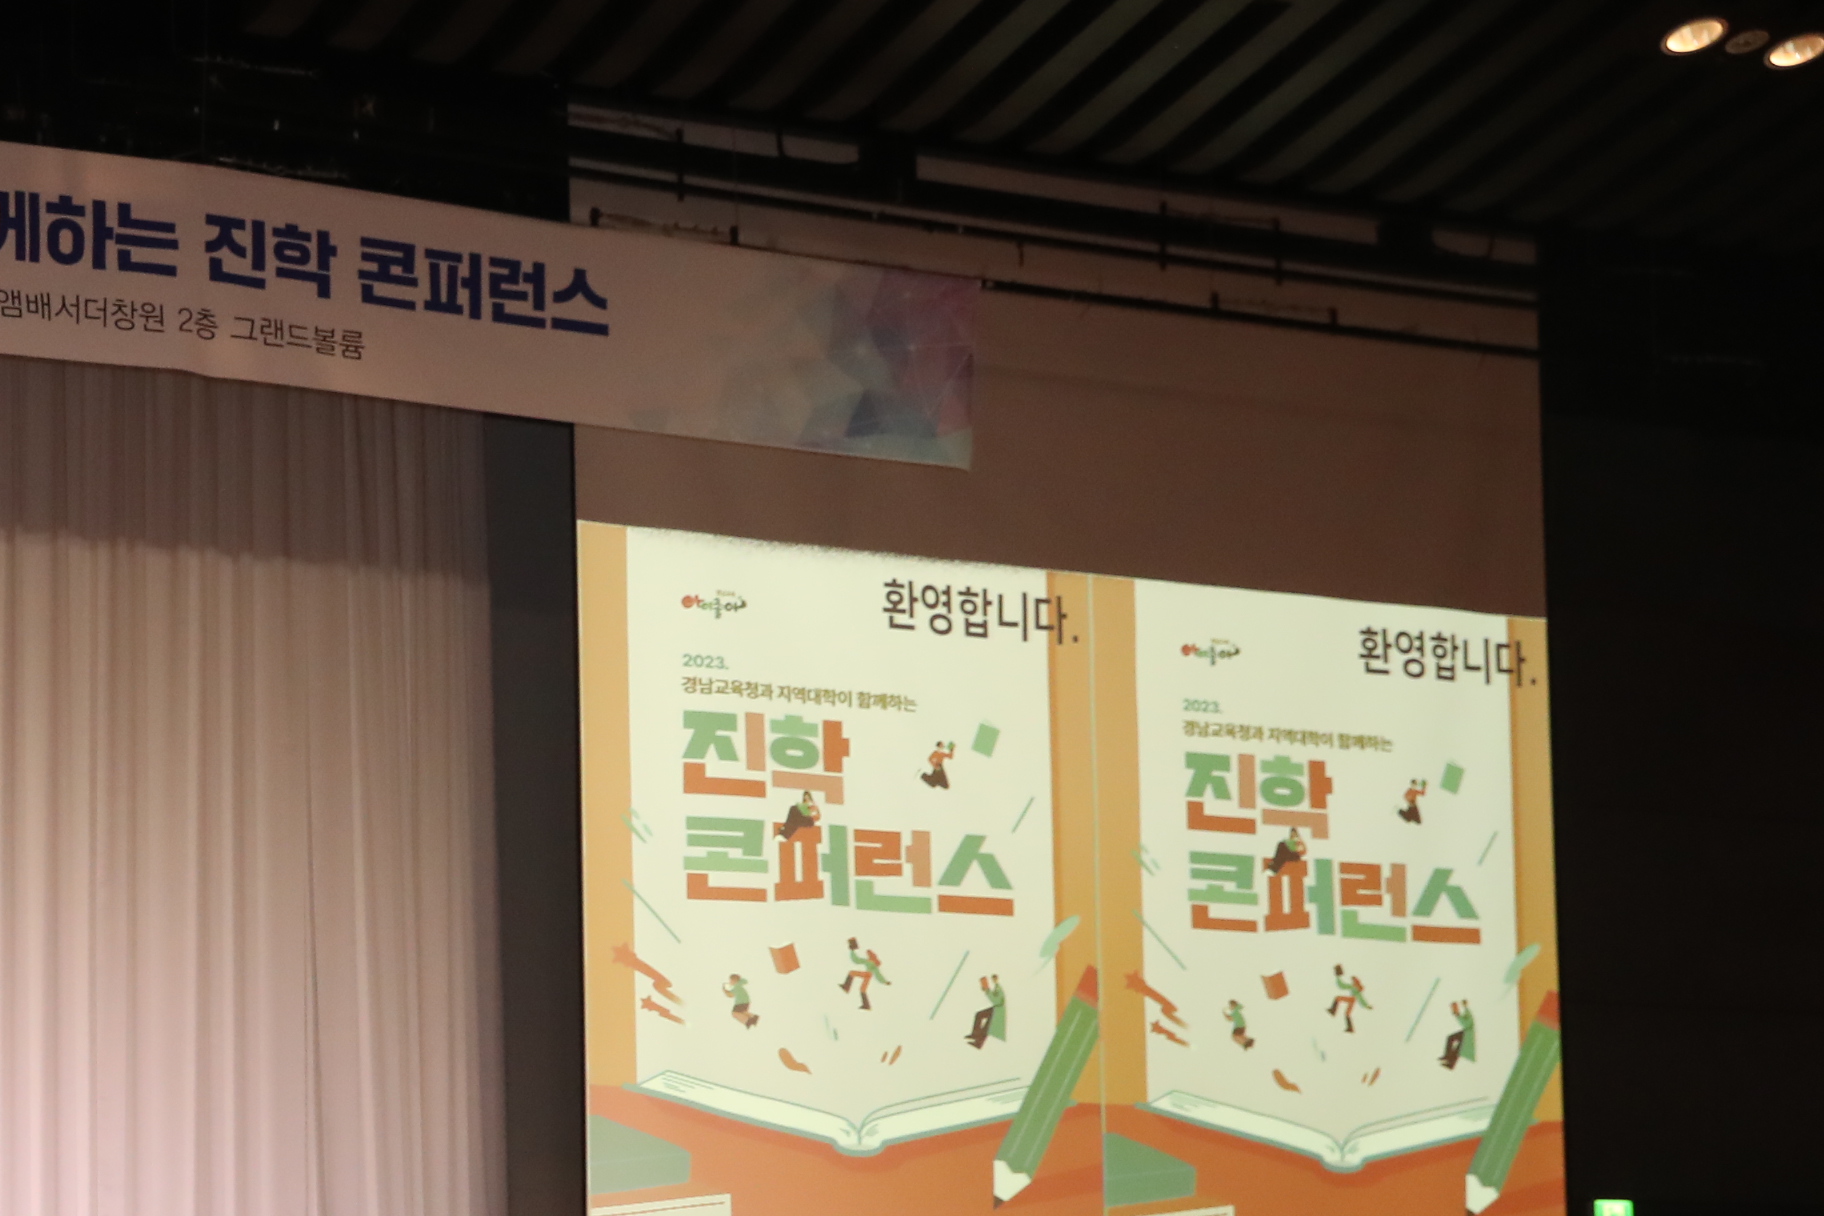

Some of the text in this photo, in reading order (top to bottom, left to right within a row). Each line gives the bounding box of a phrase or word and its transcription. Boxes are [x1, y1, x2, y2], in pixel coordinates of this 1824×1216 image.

[203, 213, 338, 299] 진학
[357, 236, 611, 337] 콘퍼런스
[178, 306, 219, 342] 2층
[229, 316, 367, 361] 그랜드볼륨
[882, 578, 1079, 645] 환영합니다.
[681, 676, 918, 713] 경남교육청과 지역대학이 함께하는
[682, 653, 729, 670] 2023.
[1358, 626, 1538, 688] 환영합니다.
[682, 710, 851, 805] 진학
[1184, 751, 1333, 839] 진학
[683, 815, 1015, 917] 콘퍼런스
[1187, 851, 1481, 945] 콘퍼런스
